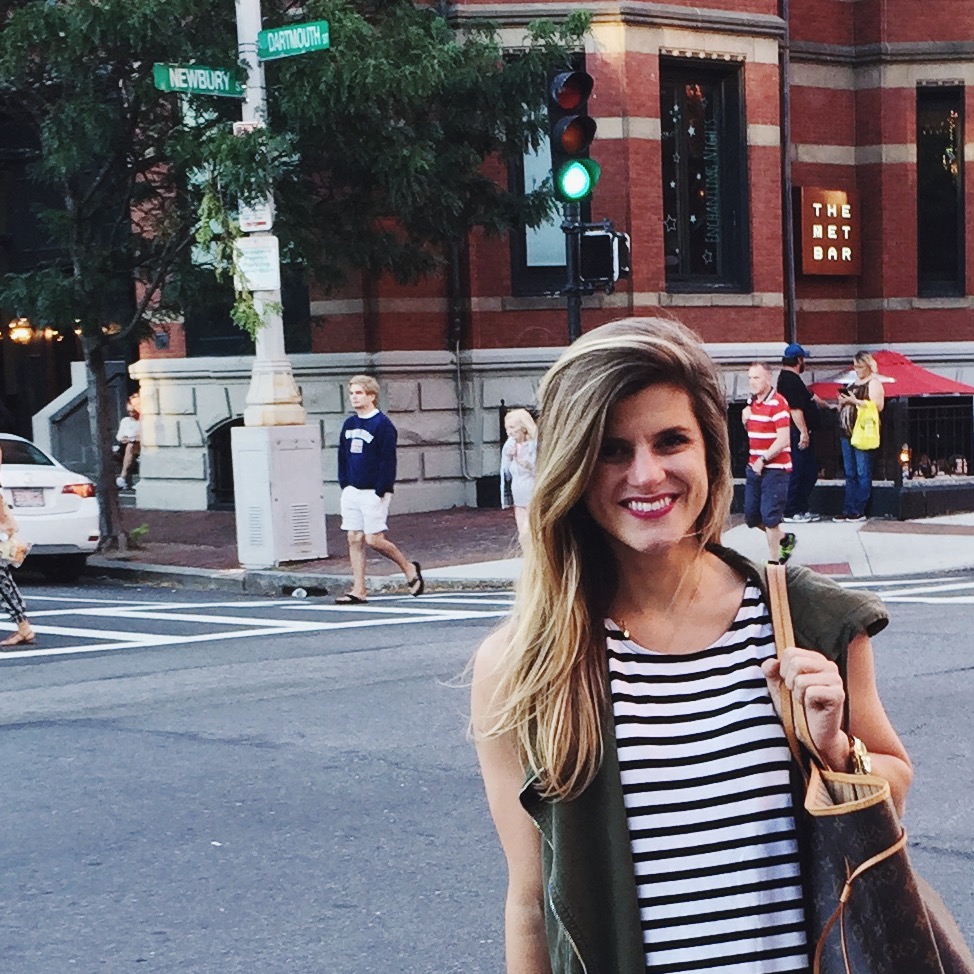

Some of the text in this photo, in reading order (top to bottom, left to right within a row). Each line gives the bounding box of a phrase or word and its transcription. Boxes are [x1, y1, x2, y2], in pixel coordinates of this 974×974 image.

[268, 26, 320, 52] DARTMOUTH
[169, 67, 230, 90] NEWBURY
[702, 117, 719, 161] NIGHTS
[812, 203, 851, 218] THE
[812, 224, 851, 239] MET
[813, 246, 851, 261] BAR
